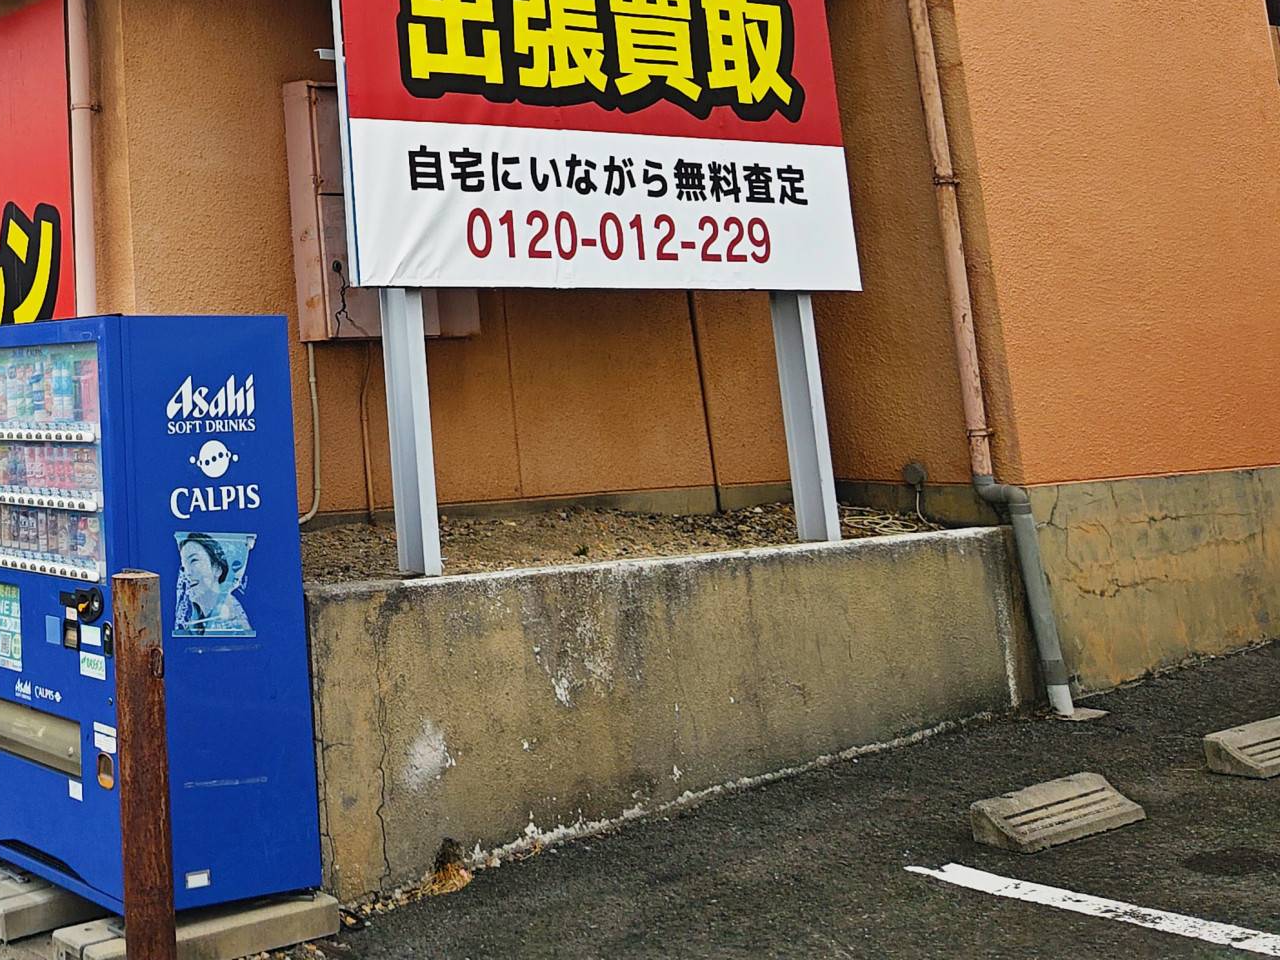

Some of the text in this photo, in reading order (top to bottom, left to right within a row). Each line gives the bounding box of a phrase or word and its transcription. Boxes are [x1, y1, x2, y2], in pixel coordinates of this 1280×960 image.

[407, 144, 810, 206] 自宅にいながら無料査定
[465, 206, 772, 265] 0120-012-229
[166, 373, 256, 420] Asahi
[167, 418, 256, 435] SOFT DRINKS
[169, 483, 261, 520] CALPIS
[34, 685, 55, 701] CALPIS
